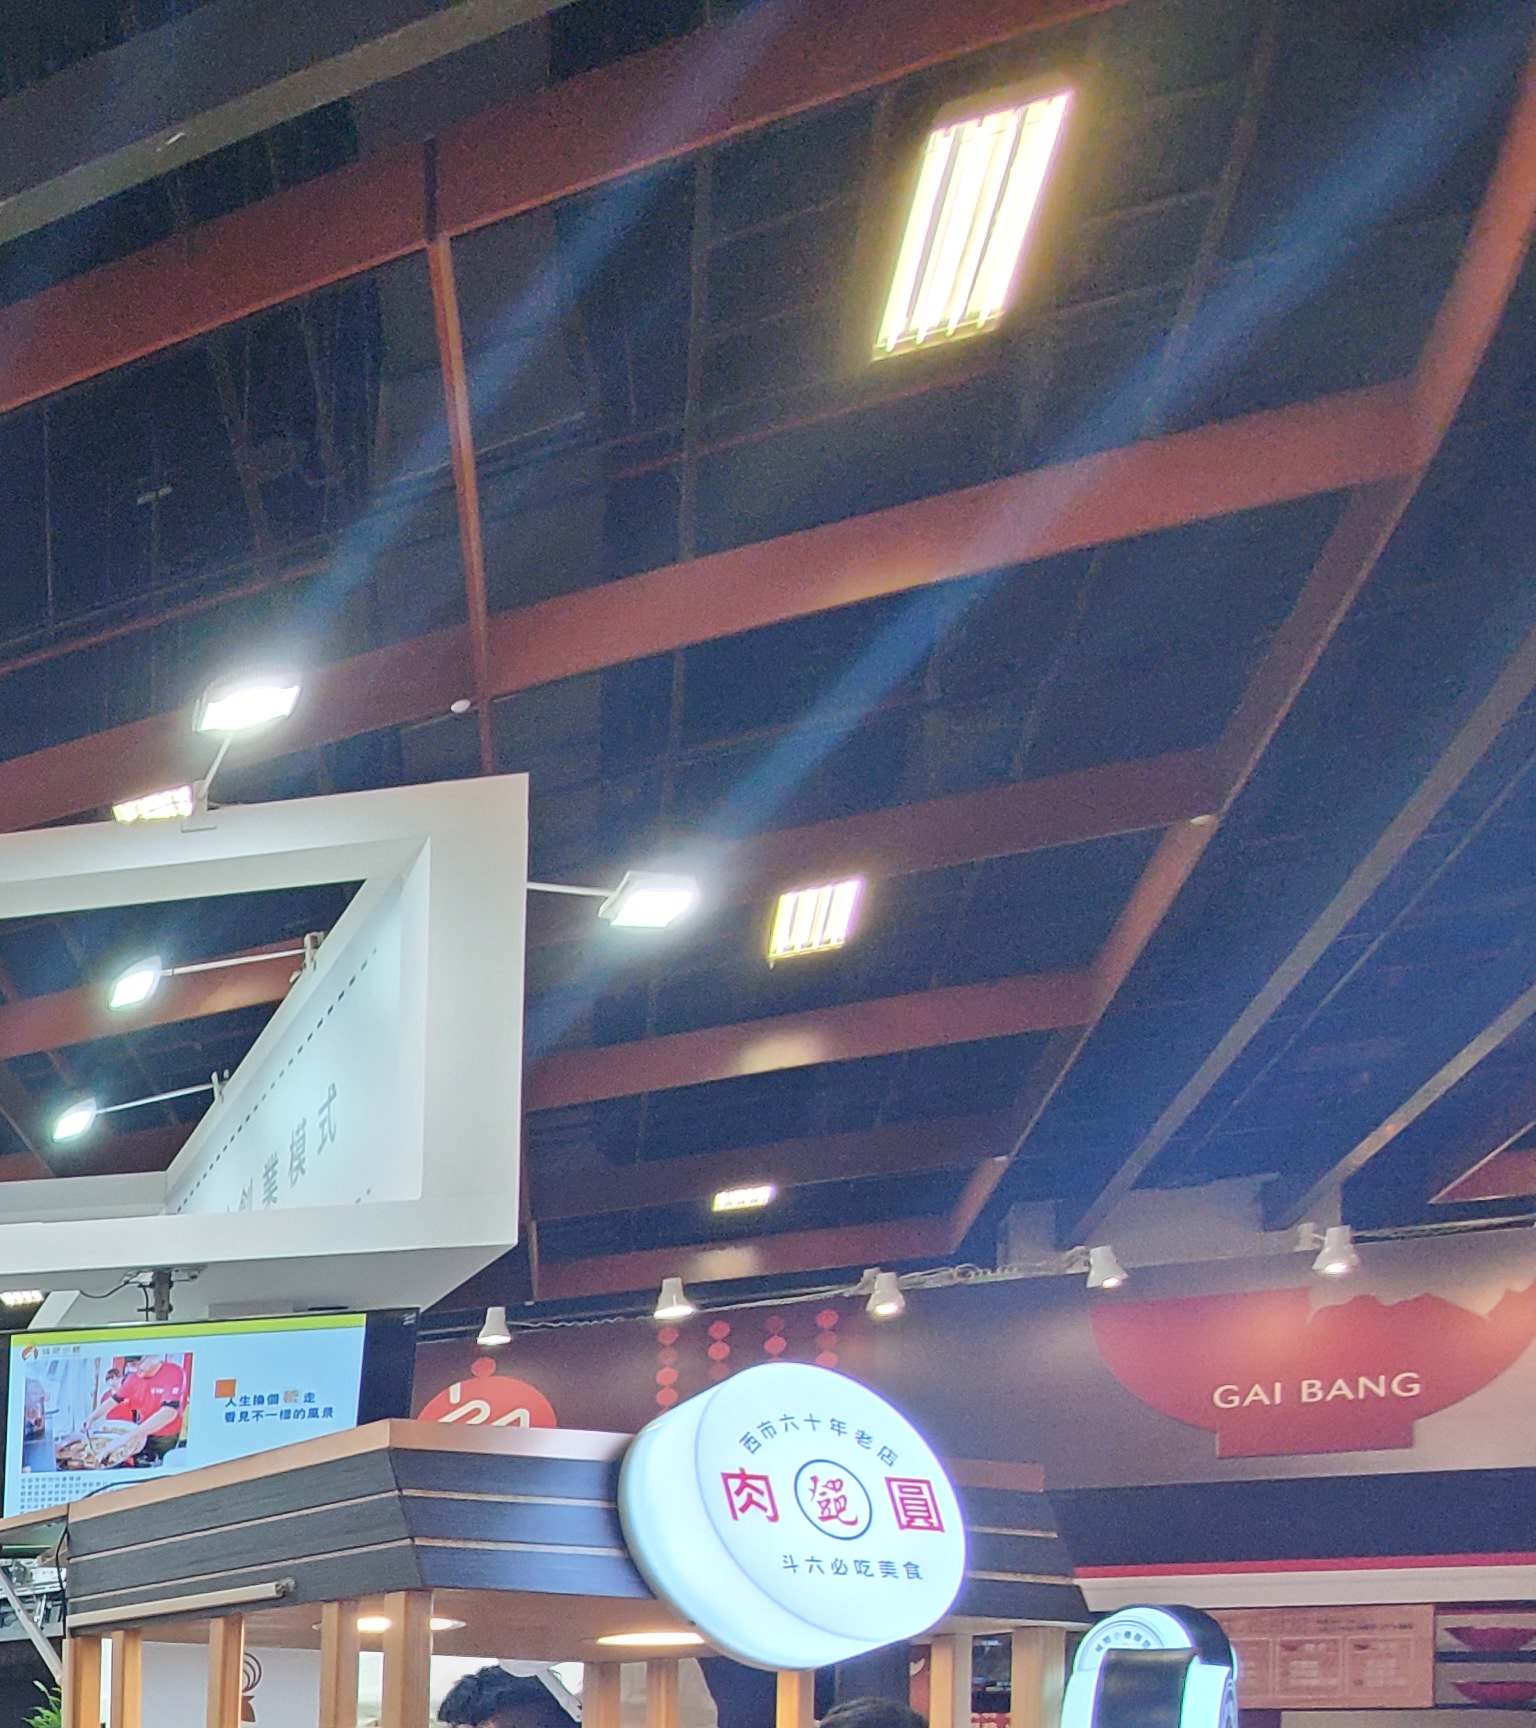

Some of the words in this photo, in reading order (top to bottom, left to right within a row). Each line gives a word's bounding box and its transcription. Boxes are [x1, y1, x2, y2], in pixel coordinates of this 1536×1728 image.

[1212, 1381, 1283, 1409] GAI
[1300, 1372, 1423, 1402] BANG
[720, 1467, 780, 1523] 肉
[884, 1475, 946, 1533] 圓
[781, 1554, 925, 1582] 斗六必吃美食
